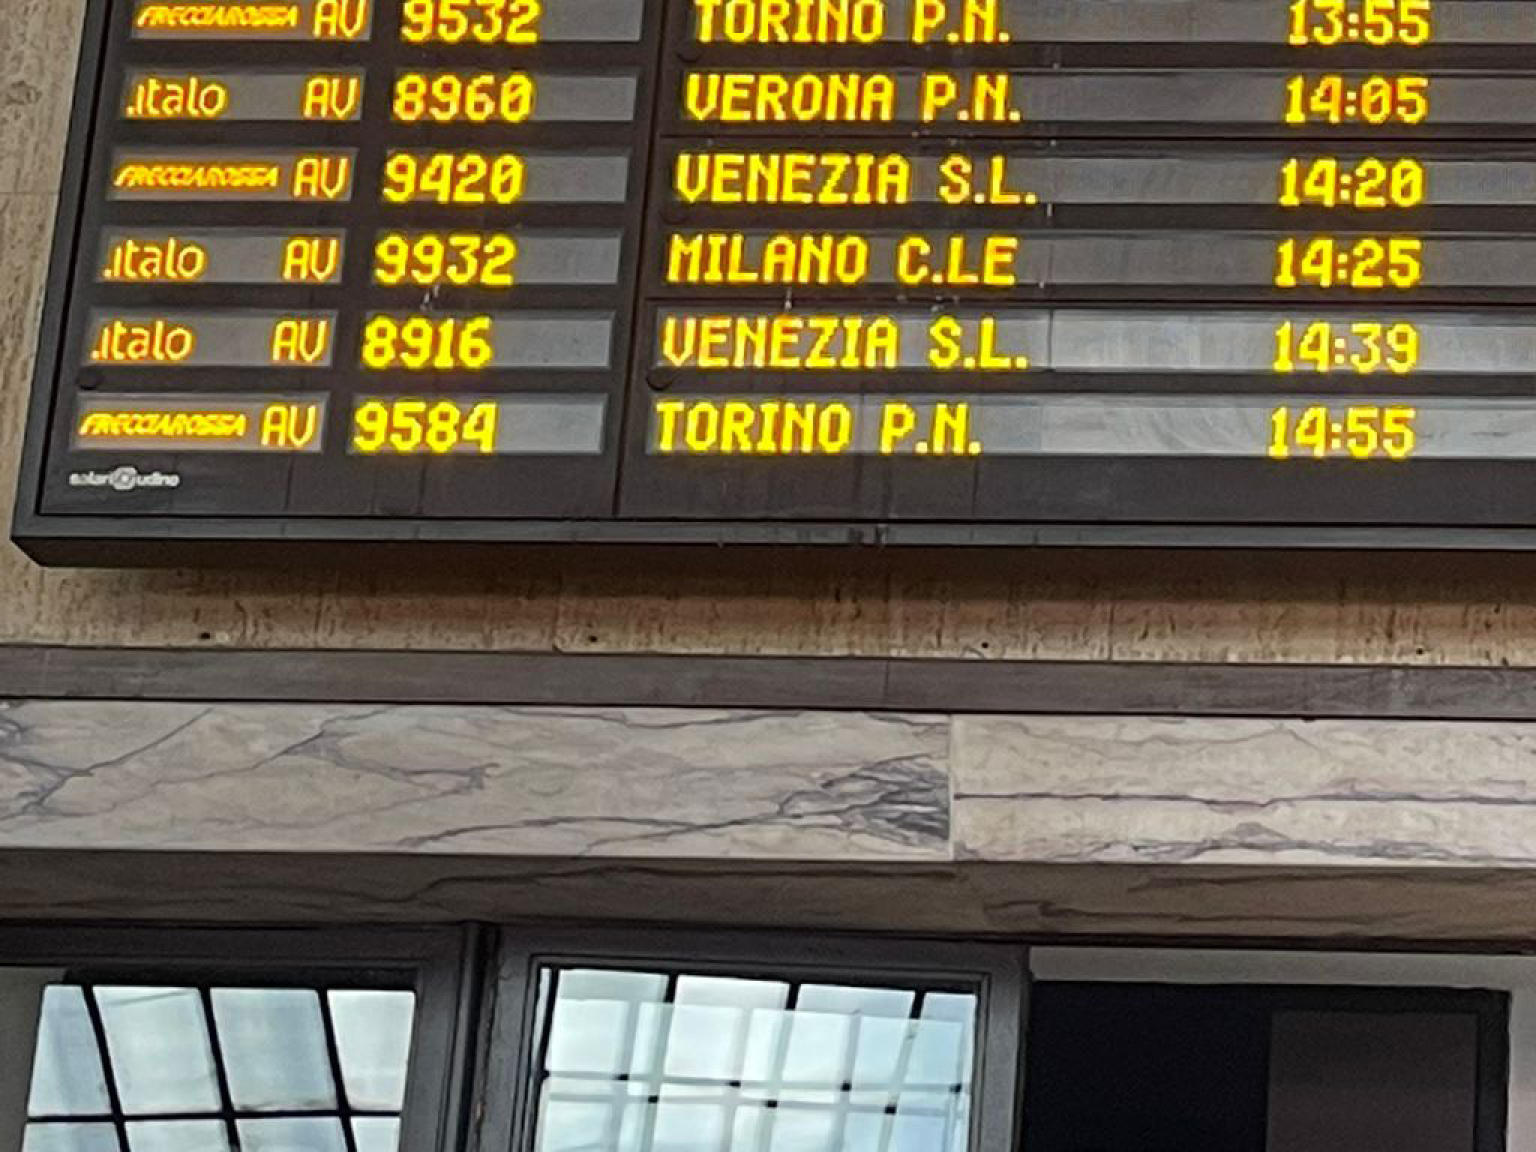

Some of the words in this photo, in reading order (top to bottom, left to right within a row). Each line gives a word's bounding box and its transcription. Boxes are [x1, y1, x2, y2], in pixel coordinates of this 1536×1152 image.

[303, 77, 359, 120] AV
[392, 74, 533, 123] 8960
[686, 74, 895, 121] VERONA
[923, 74, 1019, 121] P.N.
[1285, 76, 1428, 124] 14:05
[293, 158, 349, 199] AV
[383, 154, 524, 204] 9420
[677, 153, 910, 204] VENEZIA
[939, 156, 1036, 204] S.L.
[1279, 159, 1423, 208] 14:20
[282, 239, 339, 283] AV
[376, 235, 516, 286] 9932
[668, 234, 868, 284] MILANO
[897, 236, 1018, 286] C.LE
[1275, 239, 1422, 288] 14:25
[272, 320, 328, 365] AV
[362, 317, 493, 369] 8916
[663, 315, 898, 368] VENEZIA
[928, 317, 1027, 369] S.L.
[1272, 321, 1419, 374] 14:39
[261, 404, 316, 448] AV
[353, 401, 497, 454] 9584
[656, 401, 852, 454] TORINO
[881, 403, 980, 454] P.N.
[1268, 406, 1416, 458] 14:55
